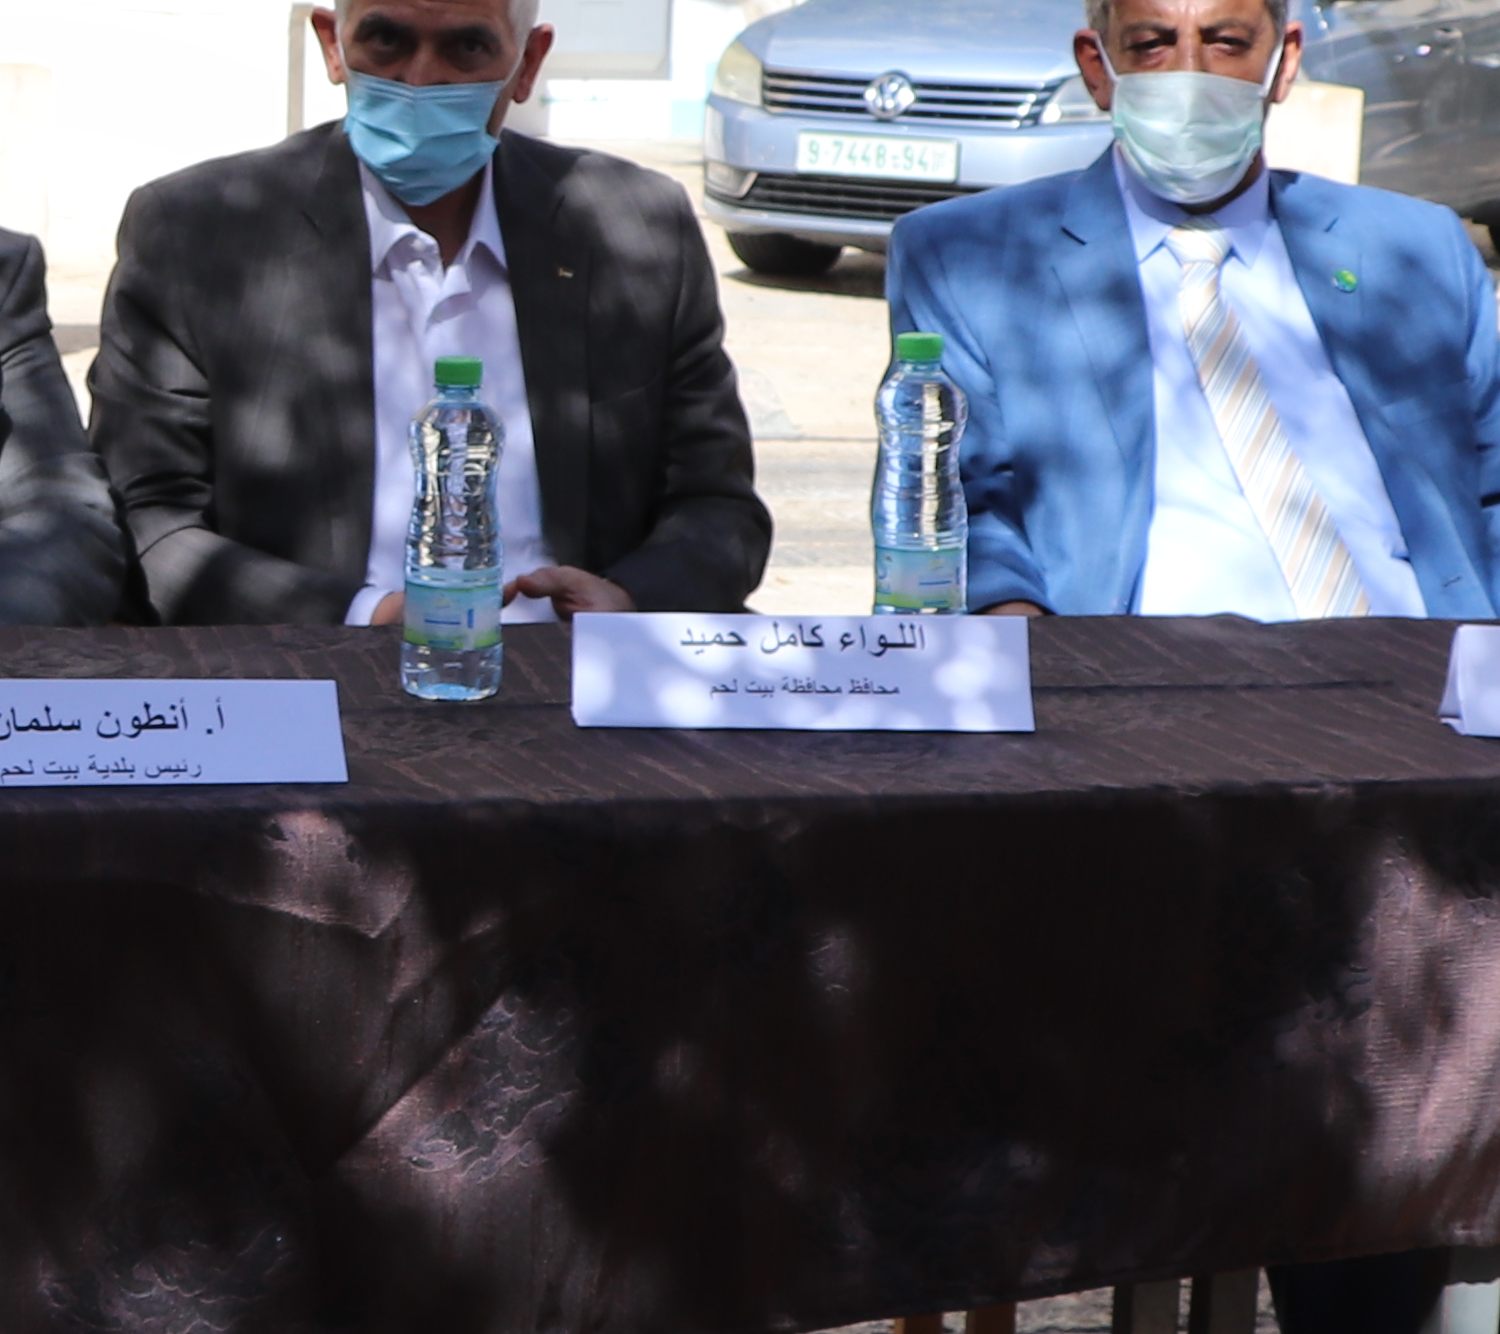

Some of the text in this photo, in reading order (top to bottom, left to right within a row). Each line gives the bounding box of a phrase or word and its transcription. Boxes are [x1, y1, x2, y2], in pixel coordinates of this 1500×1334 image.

[680, 626, 748, 655] حميد
[759, 620, 825, 655] كامل
[709, 678, 738, 697] لحم
[744, 680, 775, 698] بيت
[96, 696, 189, 739] أنطون
[0, 758, 35, 783] لحم
[42, 761, 81, 780] بيت
[87, 753, 136, 780] بلدية
